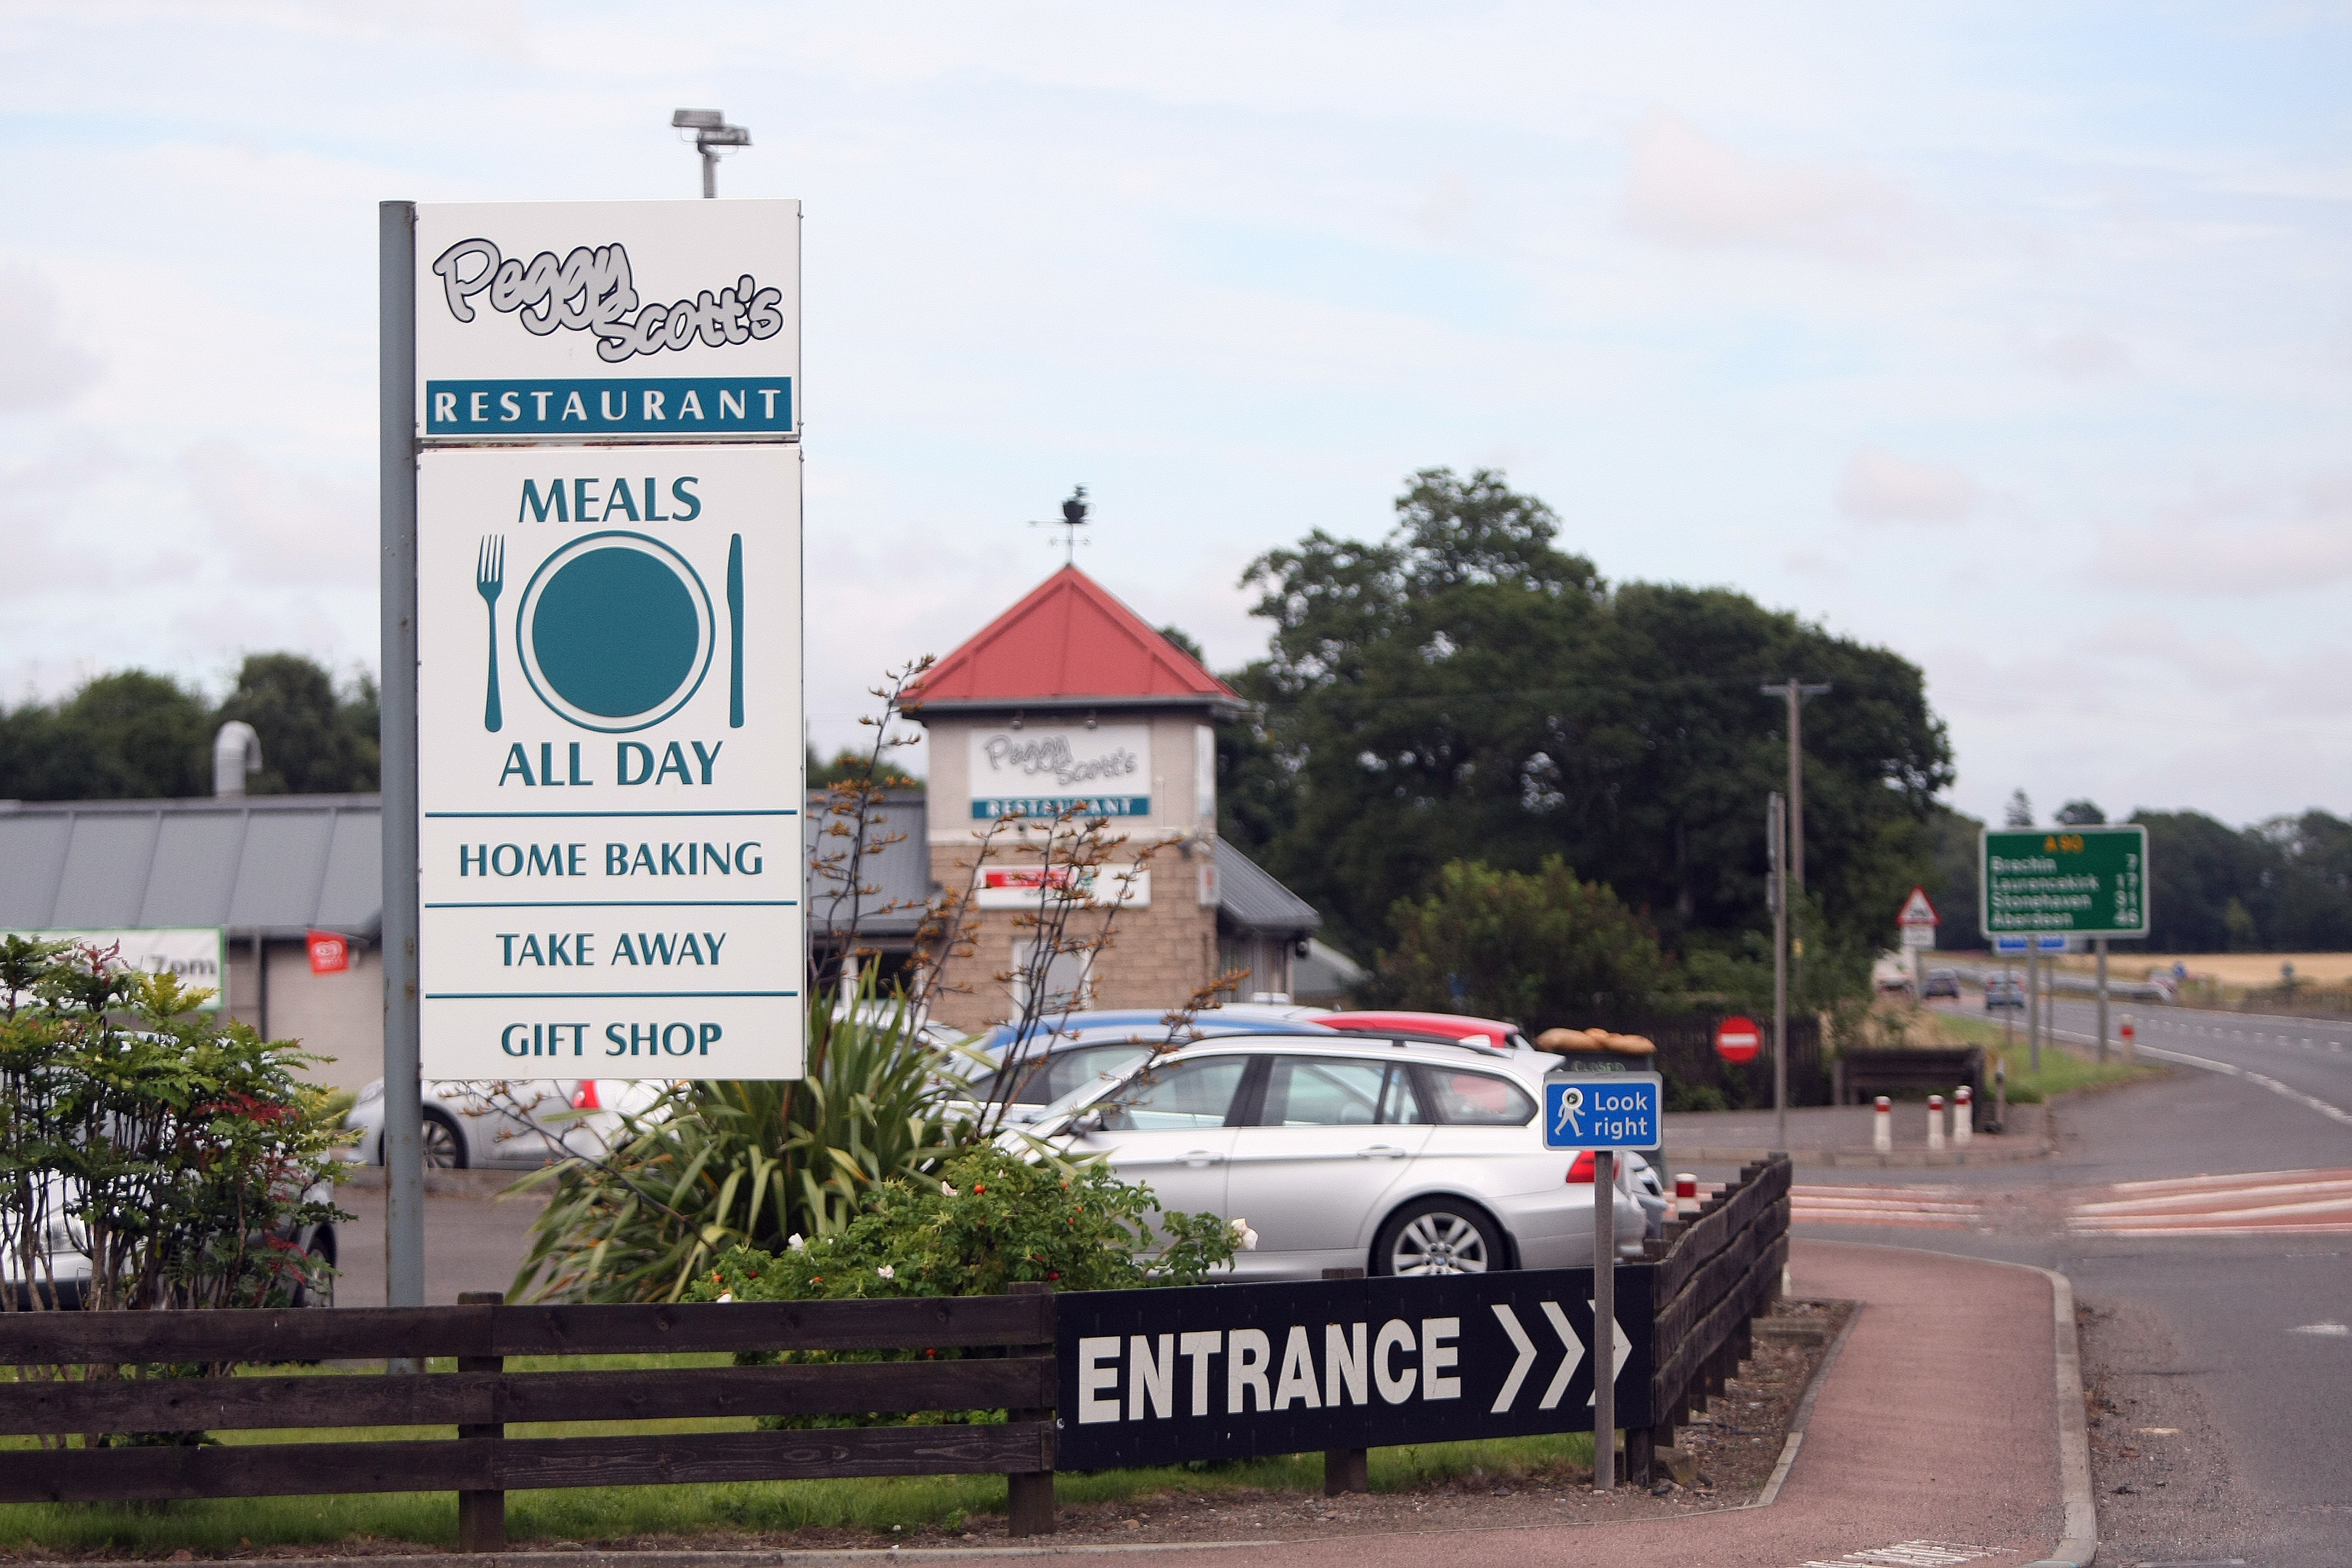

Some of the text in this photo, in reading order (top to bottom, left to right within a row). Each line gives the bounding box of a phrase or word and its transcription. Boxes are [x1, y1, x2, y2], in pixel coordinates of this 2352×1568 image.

[433, 237, 639, 335] Peggy
[592, 274, 783, 363] Scott's
[435, 388, 781, 422] RESTAURANT
[518, 475, 702, 523] MEALS
[499, 740, 724, 786] ALL DAY
[460, 841, 764, 877] HOME BAKING
[495, 932, 727, 966] TAKE AWAY
[501, 1021, 723, 1057] GIFT SHOP
[1595, 1091, 1648, 1111] Look
[1595, 1116, 1648, 1140] right
[1079, 1316, 1461, 1425] ENTRANCE
